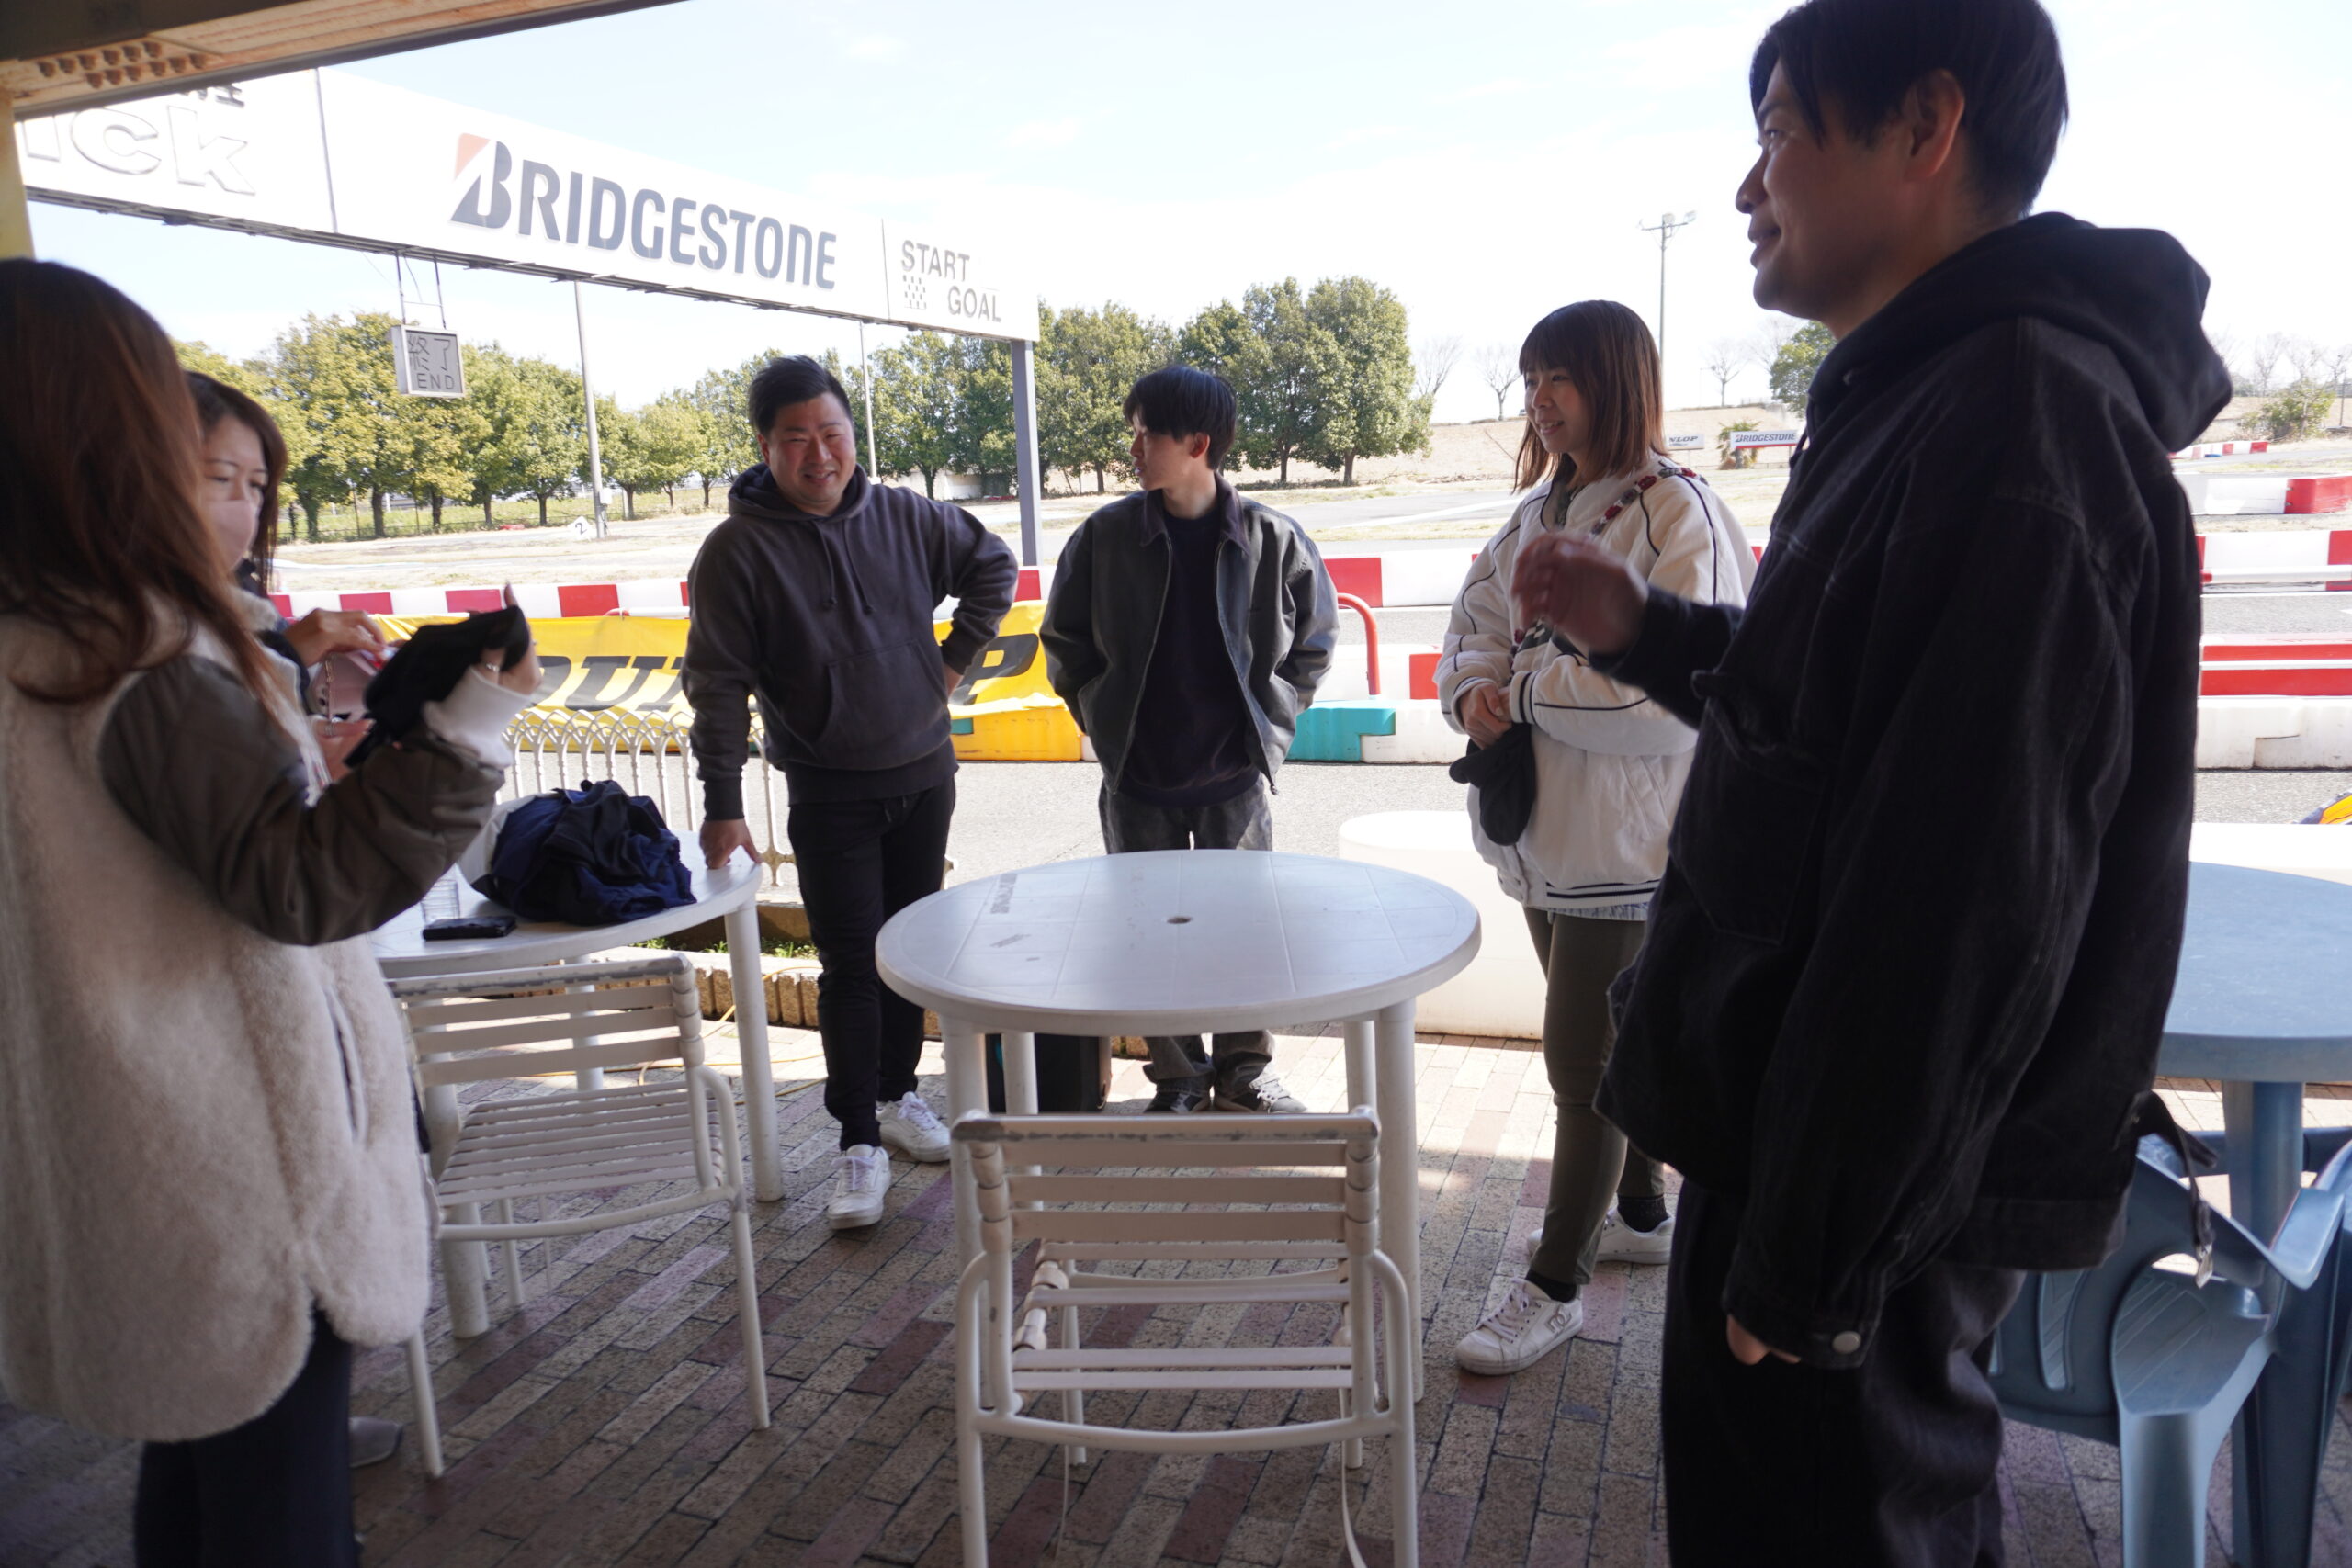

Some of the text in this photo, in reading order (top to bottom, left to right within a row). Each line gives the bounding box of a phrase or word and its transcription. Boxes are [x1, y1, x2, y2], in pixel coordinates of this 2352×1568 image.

[448, 132, 838, 292] BRIDGESTONE
[900, 239, 970, 282] START
[947, 285, 1002, 322] GOAL
[407, 334, 451, 372] 終了
[416, 372, 455, 390] END
[1735, 433, 1797, 443] BRIDGESTONE
[574, 522, 588, 535] 2
